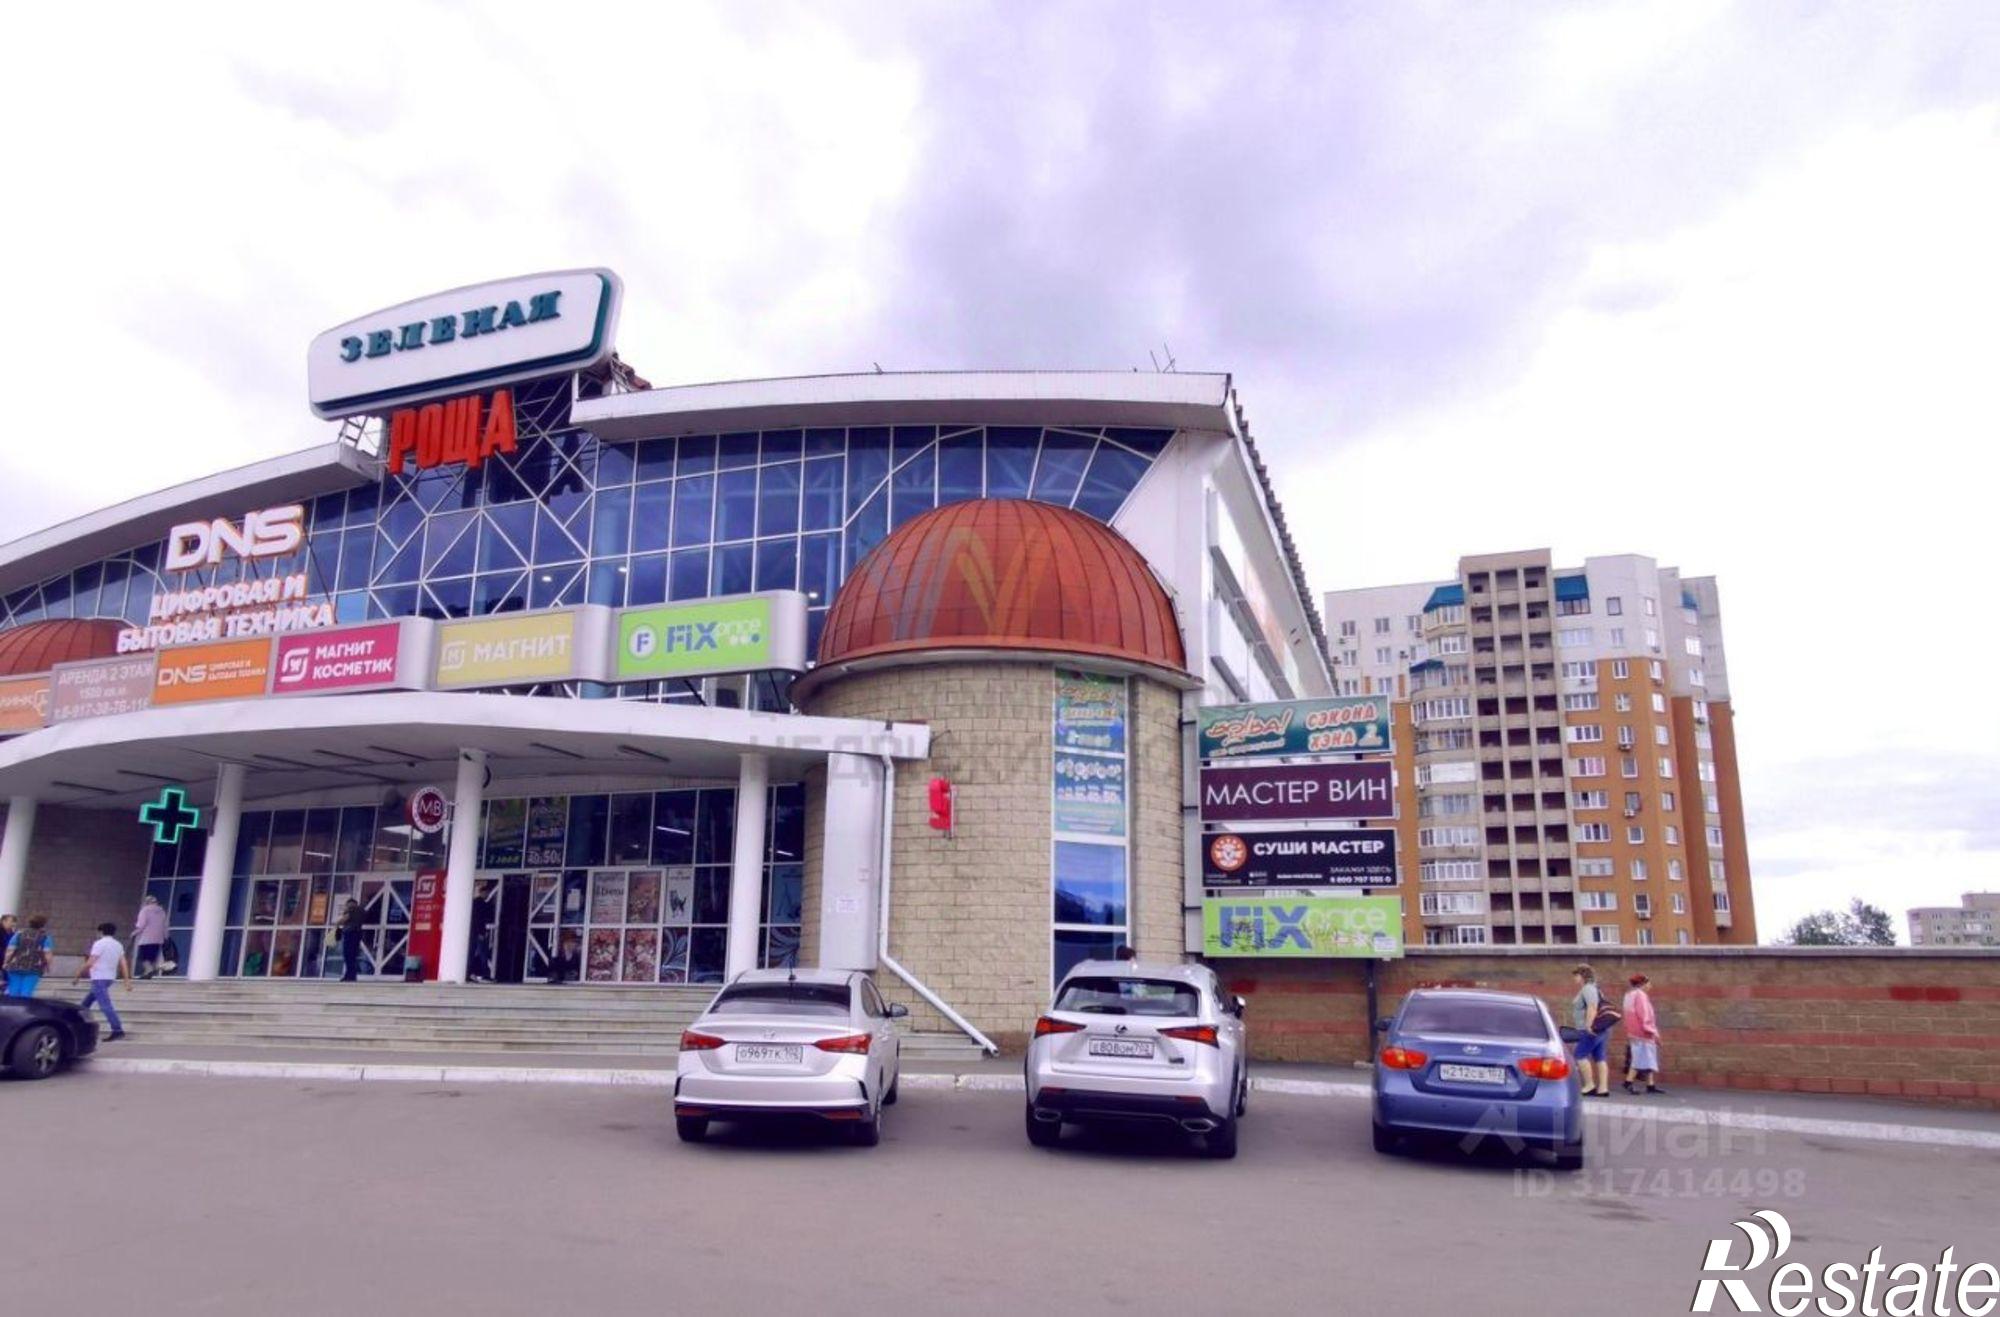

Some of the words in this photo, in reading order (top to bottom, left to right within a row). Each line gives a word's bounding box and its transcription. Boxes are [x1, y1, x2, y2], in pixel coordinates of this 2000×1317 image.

[340, 290, 562, 362] ЗЕЛЕНАЯ
[387, 388, 518, 475] РОЩА
[165, 503, 306, 572] DNS
[150, 578, 281, 620] ЦИФРОВАЯ
[283, 573, 307, 600] И
[116, 618, 222, 653] БЫТОВАЯ
[225, 602, 335, 638] ТЕХНИКА
[314, 640, 376, 660] МАГНИТ
[473, 634, 571, 663] МАГНИТ
[157, 664, 208, 687] DNS
[312, 657, 393, 680] КОСМЕТИК
[1306, 703, 1378, 730] СЭКОНД
[1308, 727, 1357, 752] ХЭНД
[1206, 780, 1320, 806] МАСТЕР
[1329, 778, 1387, 801] ВИН
[1253, 841, 1308, 856] СУШИ
[1311, 840, 1385, 855] МАСТЕР
